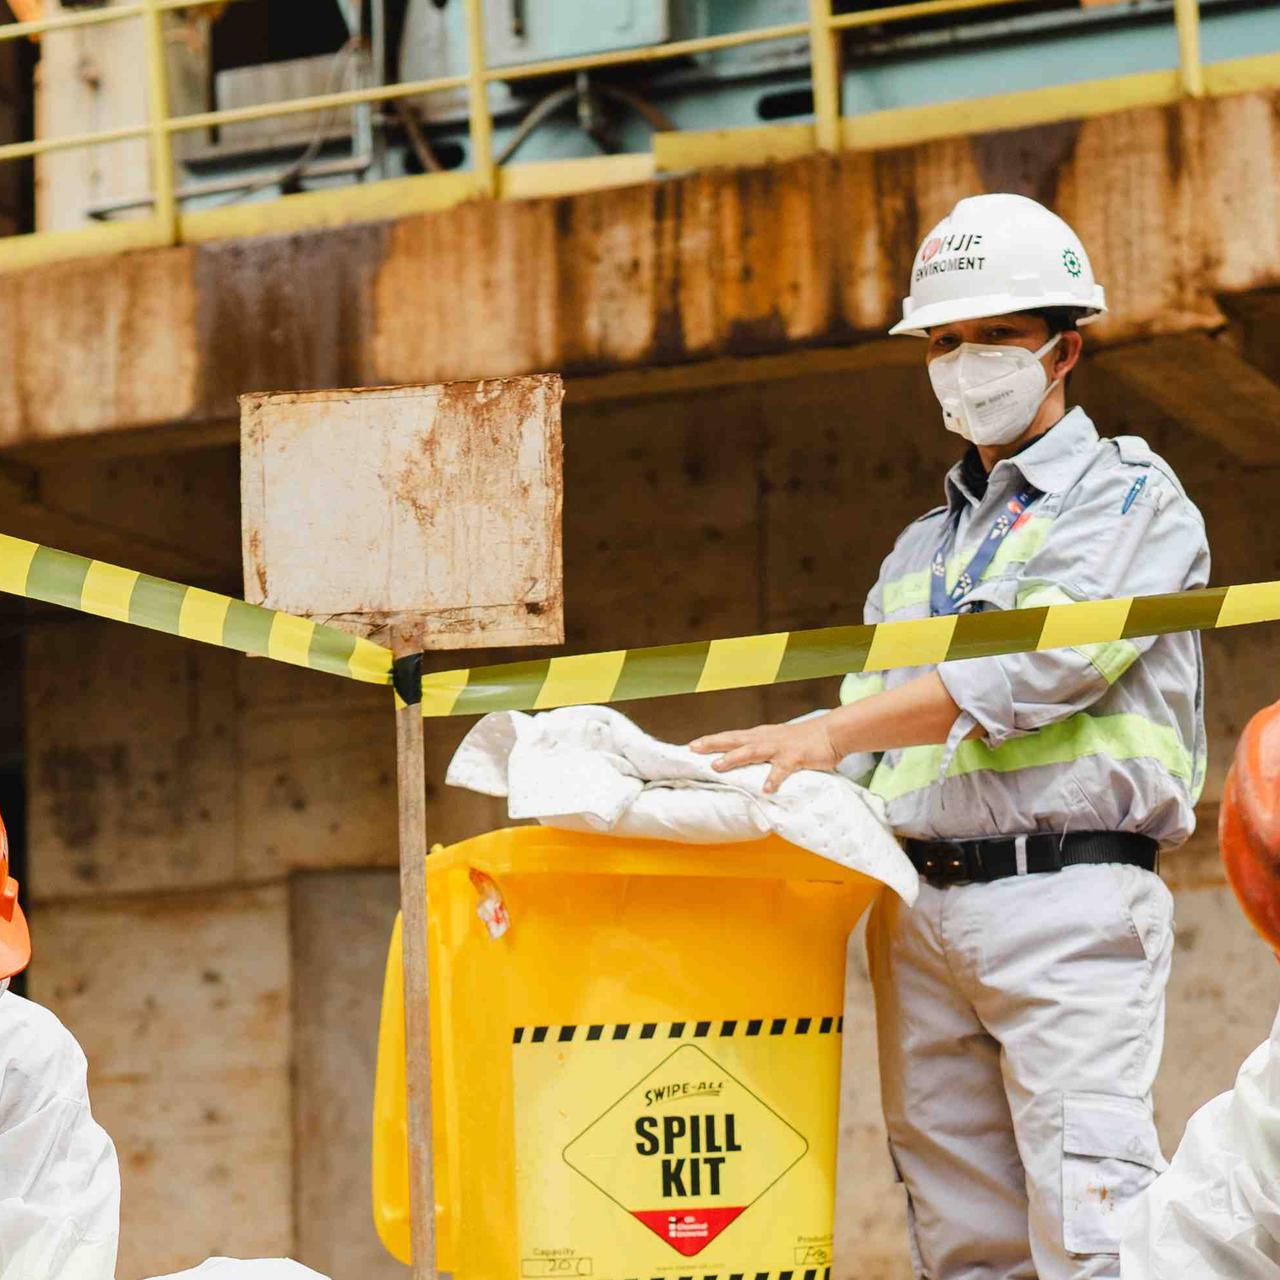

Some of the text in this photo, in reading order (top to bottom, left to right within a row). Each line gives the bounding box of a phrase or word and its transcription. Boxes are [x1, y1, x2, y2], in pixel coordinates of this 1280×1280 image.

[915, 257, 986, 282] ENVIROMENT
[635, 1113, 742, 1156] SPILL
[662, 1157, 726, 1198] KIT
[533, 1248, 577, 1258] Capacity
